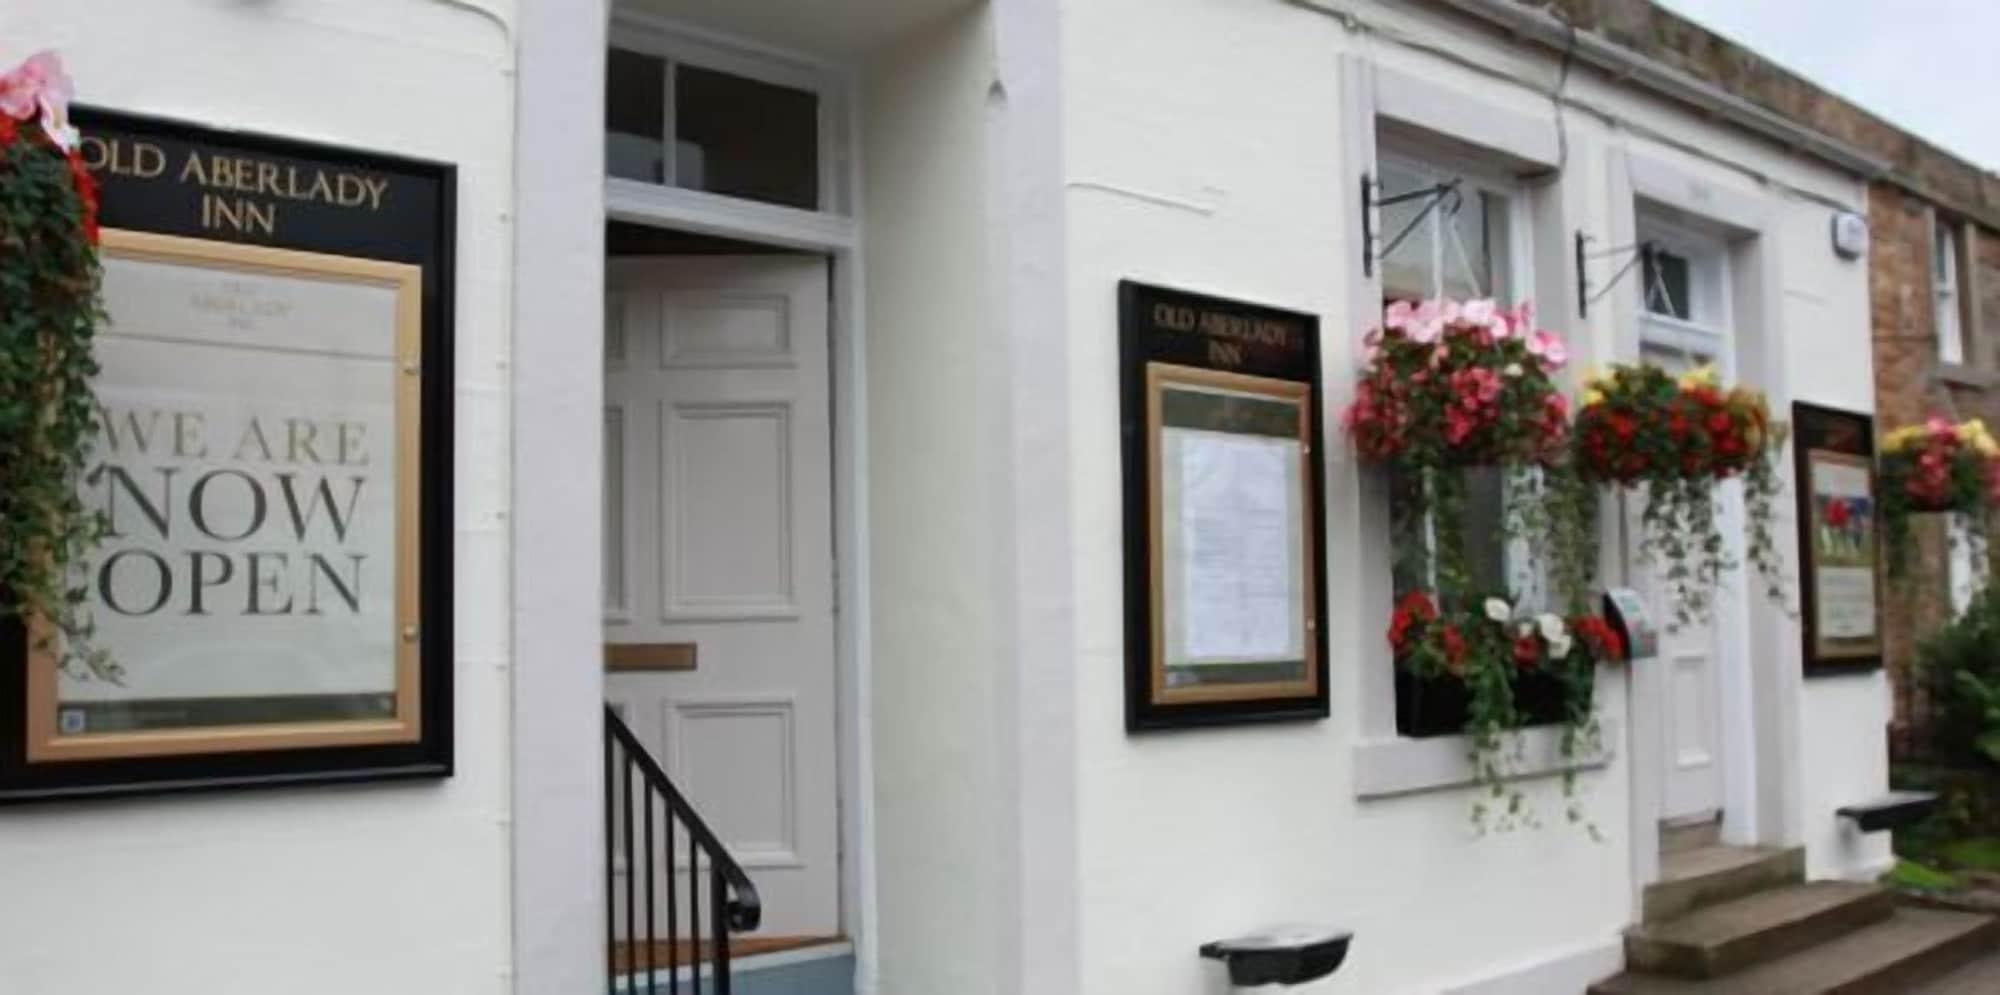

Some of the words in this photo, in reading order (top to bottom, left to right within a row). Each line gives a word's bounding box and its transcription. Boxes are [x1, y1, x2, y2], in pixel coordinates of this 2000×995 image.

[80, 137, 166, 178] OLD
[180, 151, 388, 209] ABERLADY
[202, 195, 278, 234] INN
[99, 408, 207, 457] WE
[233, 417, 370, 465] ARE
[98, 464, 366, 543] NOW
[98, 548, 368, 616] OPEN
